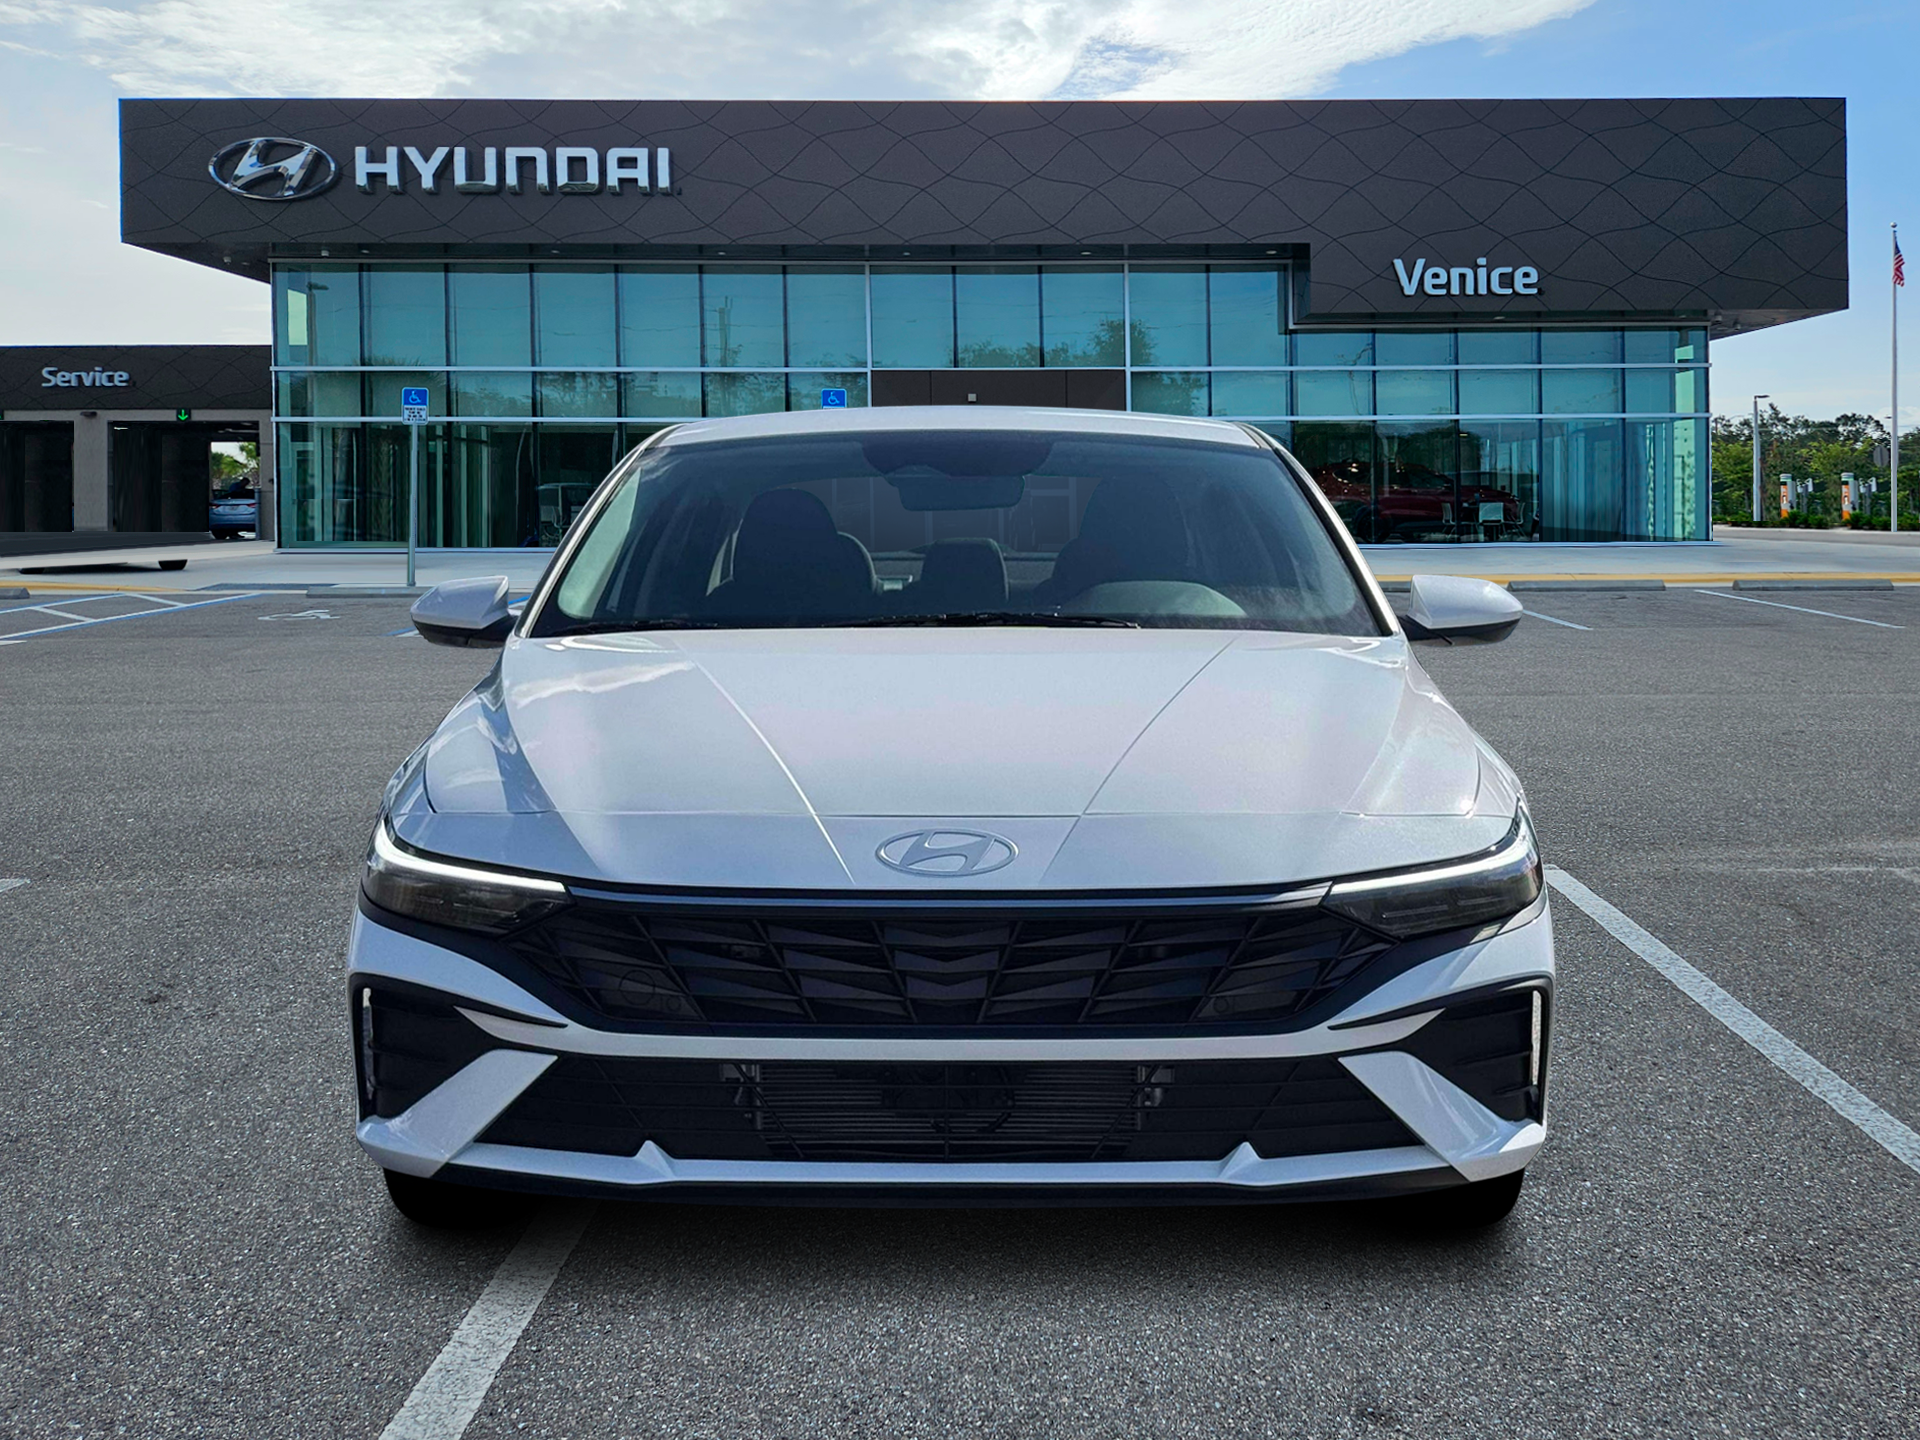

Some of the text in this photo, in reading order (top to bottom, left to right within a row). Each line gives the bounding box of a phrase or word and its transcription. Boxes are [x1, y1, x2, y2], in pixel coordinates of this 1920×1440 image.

[354, 146, 671, 193] HYUNDAI
[1393, 257, 1539, 296] Venice
[41, 366, 130, 388] Service
